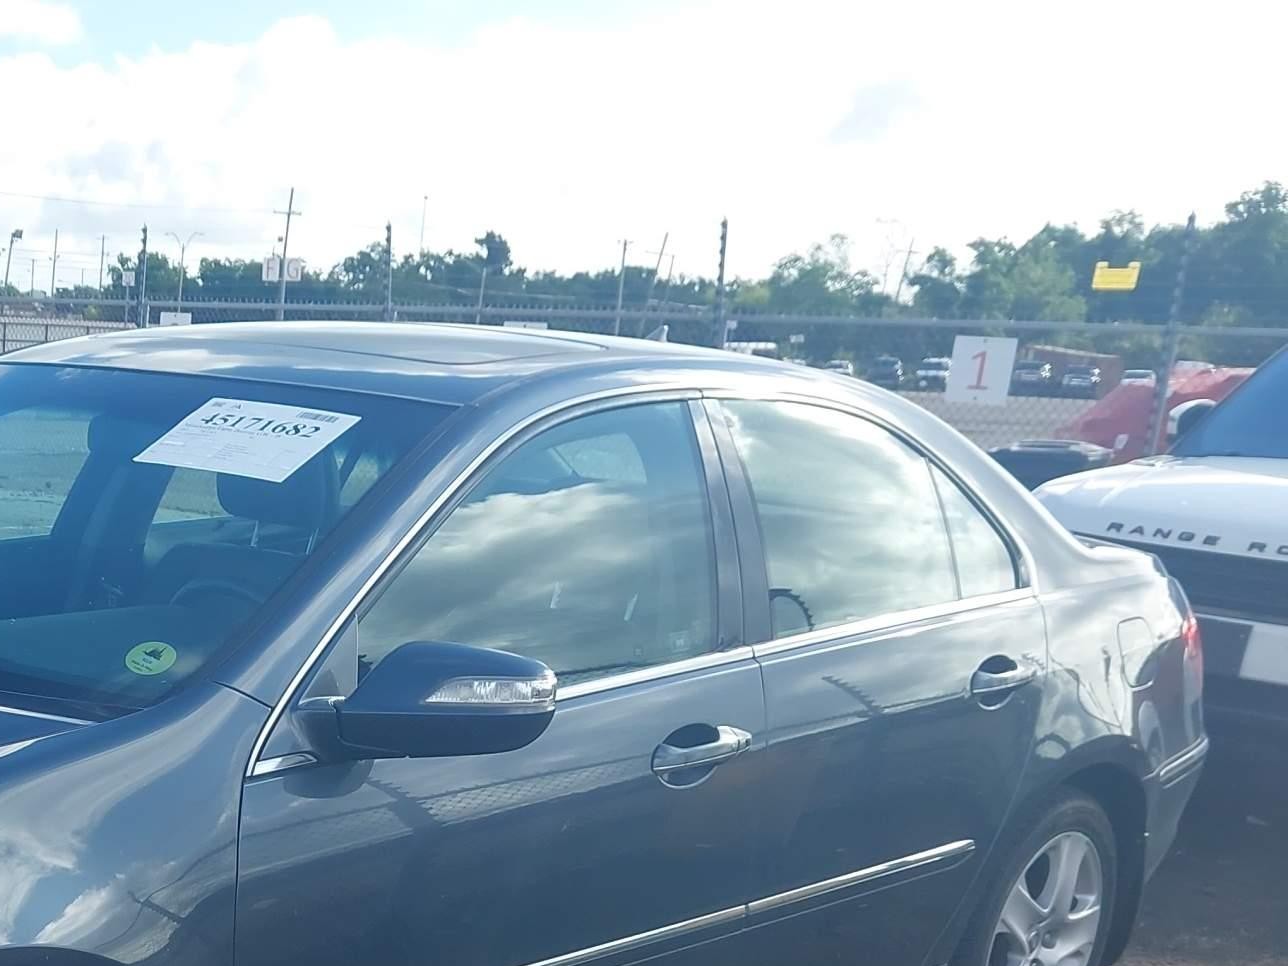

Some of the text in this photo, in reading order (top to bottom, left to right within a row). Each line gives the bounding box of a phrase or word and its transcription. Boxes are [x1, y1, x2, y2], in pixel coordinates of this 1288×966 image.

[287, 258, 300, 280] G
[966, 350, 988, 390] 1
[201, 412, 321, 438] 45171682
[1106, 521, 1221, 546] RANGE
